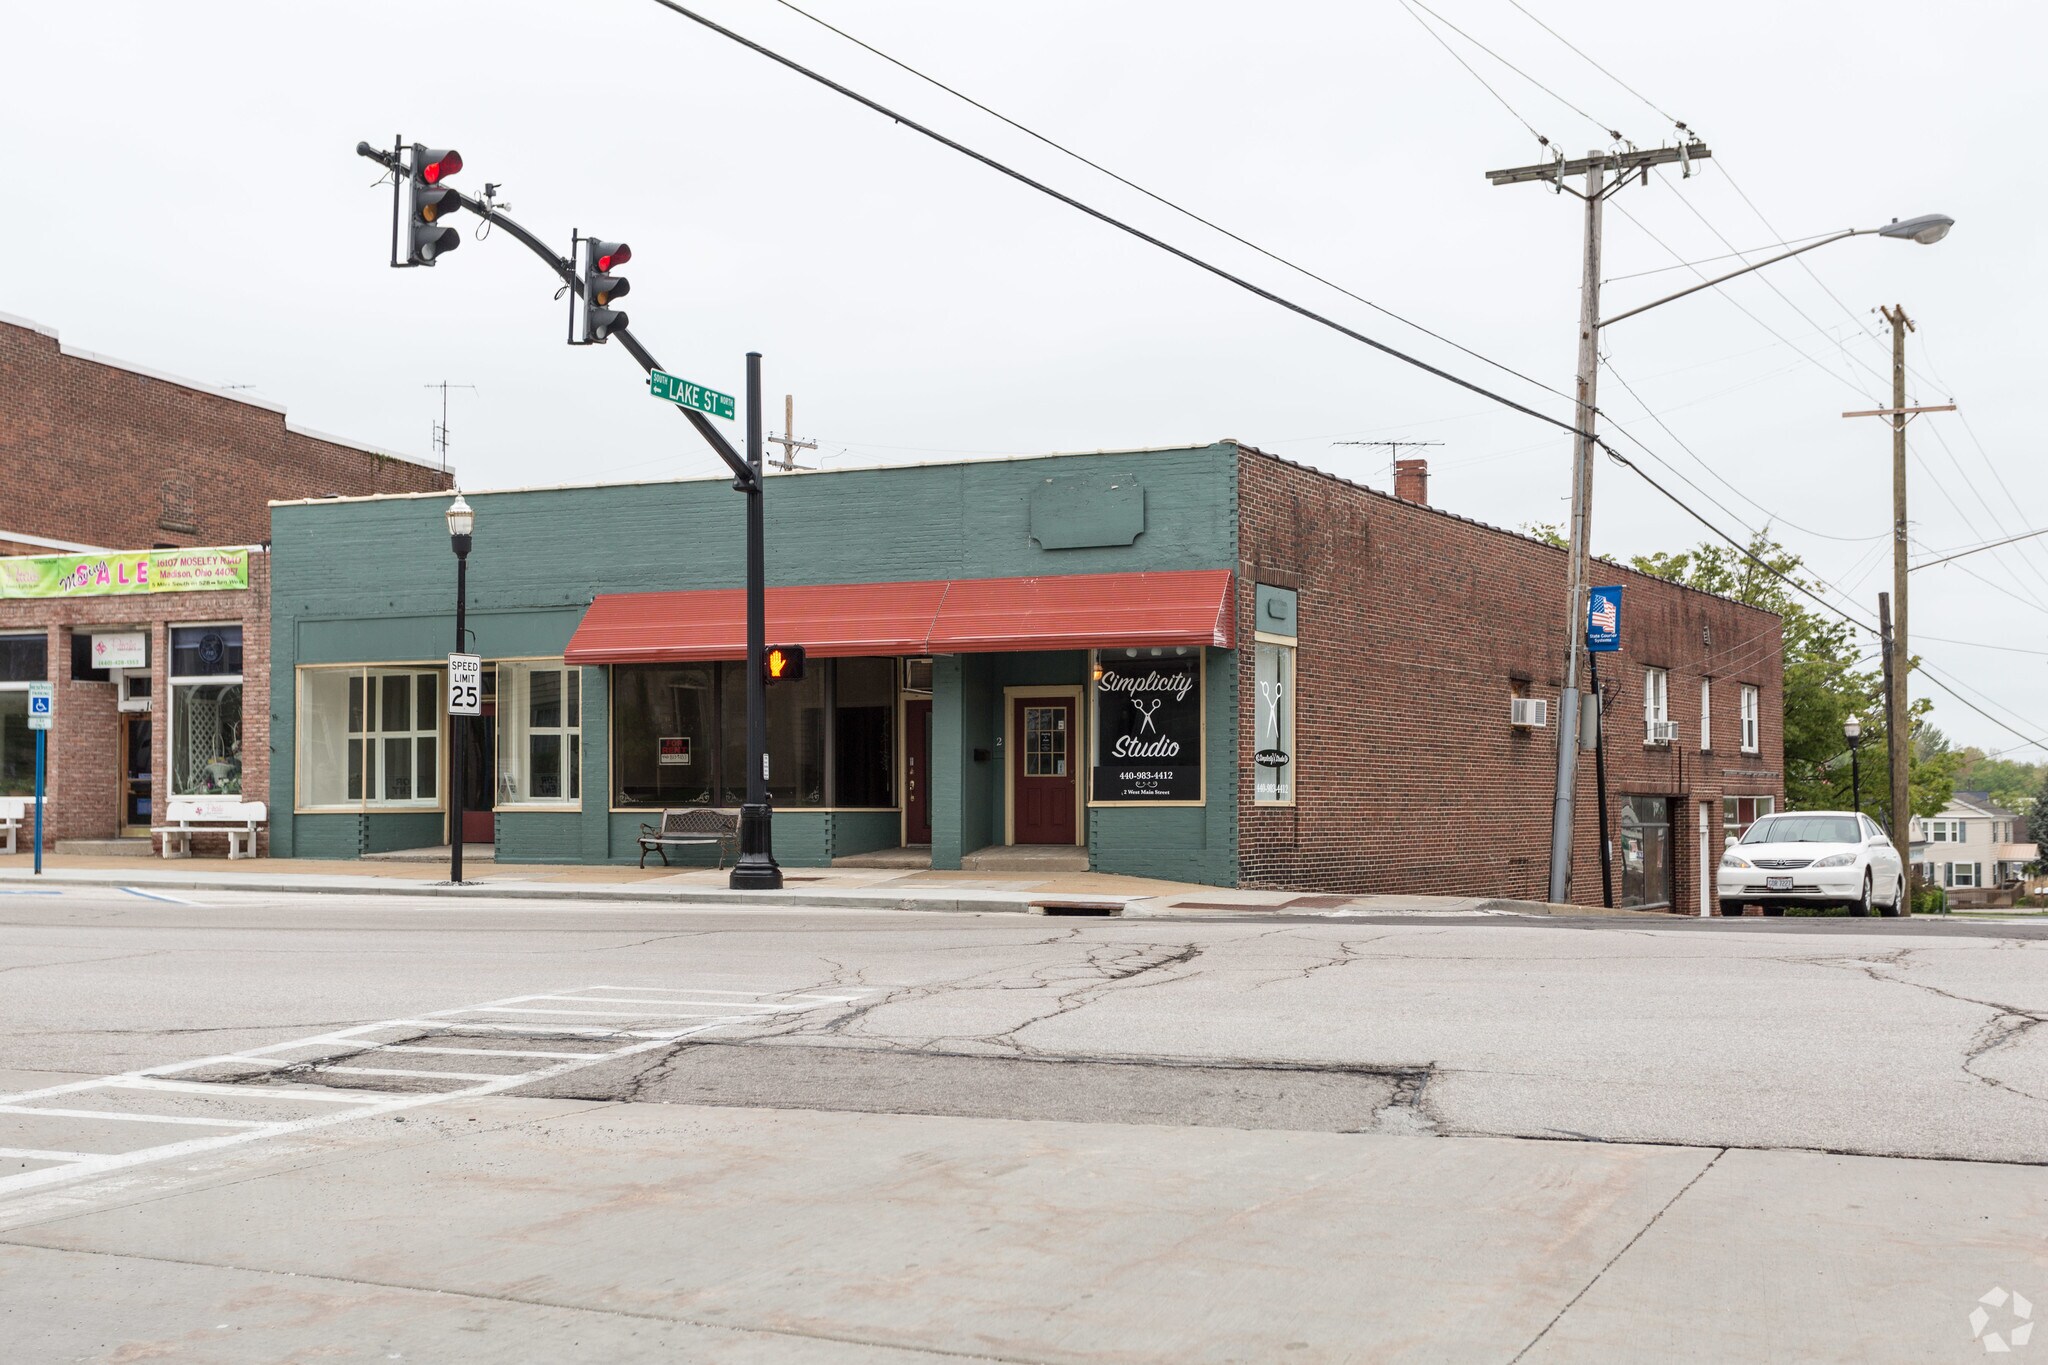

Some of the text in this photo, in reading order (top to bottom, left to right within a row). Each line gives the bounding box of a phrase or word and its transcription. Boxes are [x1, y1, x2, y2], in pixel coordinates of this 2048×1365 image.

[653, 373, 668, 385] SOUTH
[669, 378, 718, 413] LAKE ST
[720, 396, 733, 408] NORTH
[157, 558, 178, 568] 16107
[180, 557, 218, 566] MOSELEY
[60, 560, 107, 592] Moving
[76, 562, 148, 586] SALE
[194, 568, 212, 578] Ohio
[452, 661, 478, 671] SPEED
[454, 674, 475, 683] LIMIT
[1098, 670, 1193, 702] Simplicity
[452, 686, 477, 707] 25
[996, 736, 1002, 746] 2
[1111, 734, 1180, 758] Studio
[662, 746, 687, 754] RENT
[1119, 771, 1173, 780] 440-983-4412
